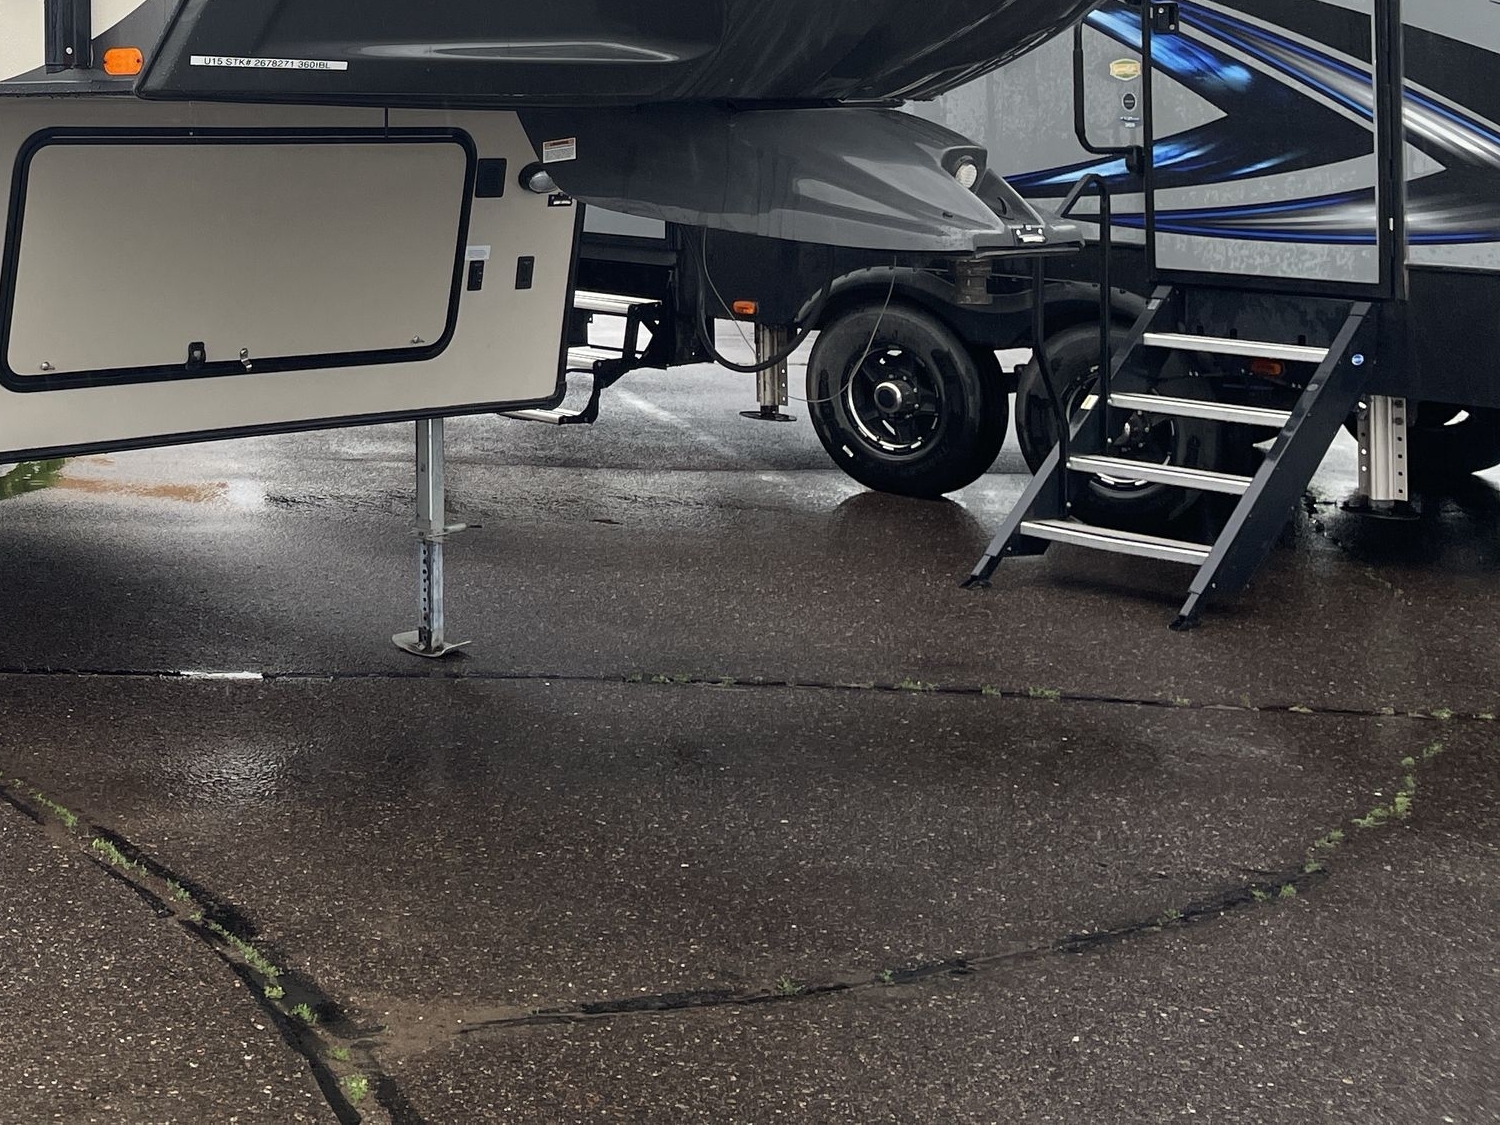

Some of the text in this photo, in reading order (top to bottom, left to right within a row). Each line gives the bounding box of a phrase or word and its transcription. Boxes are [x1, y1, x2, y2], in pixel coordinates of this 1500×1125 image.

[203, 57, 223, 65] U15
[225, 58, 252, 66] STK#
[254, 59, 294, 68] 2678271
